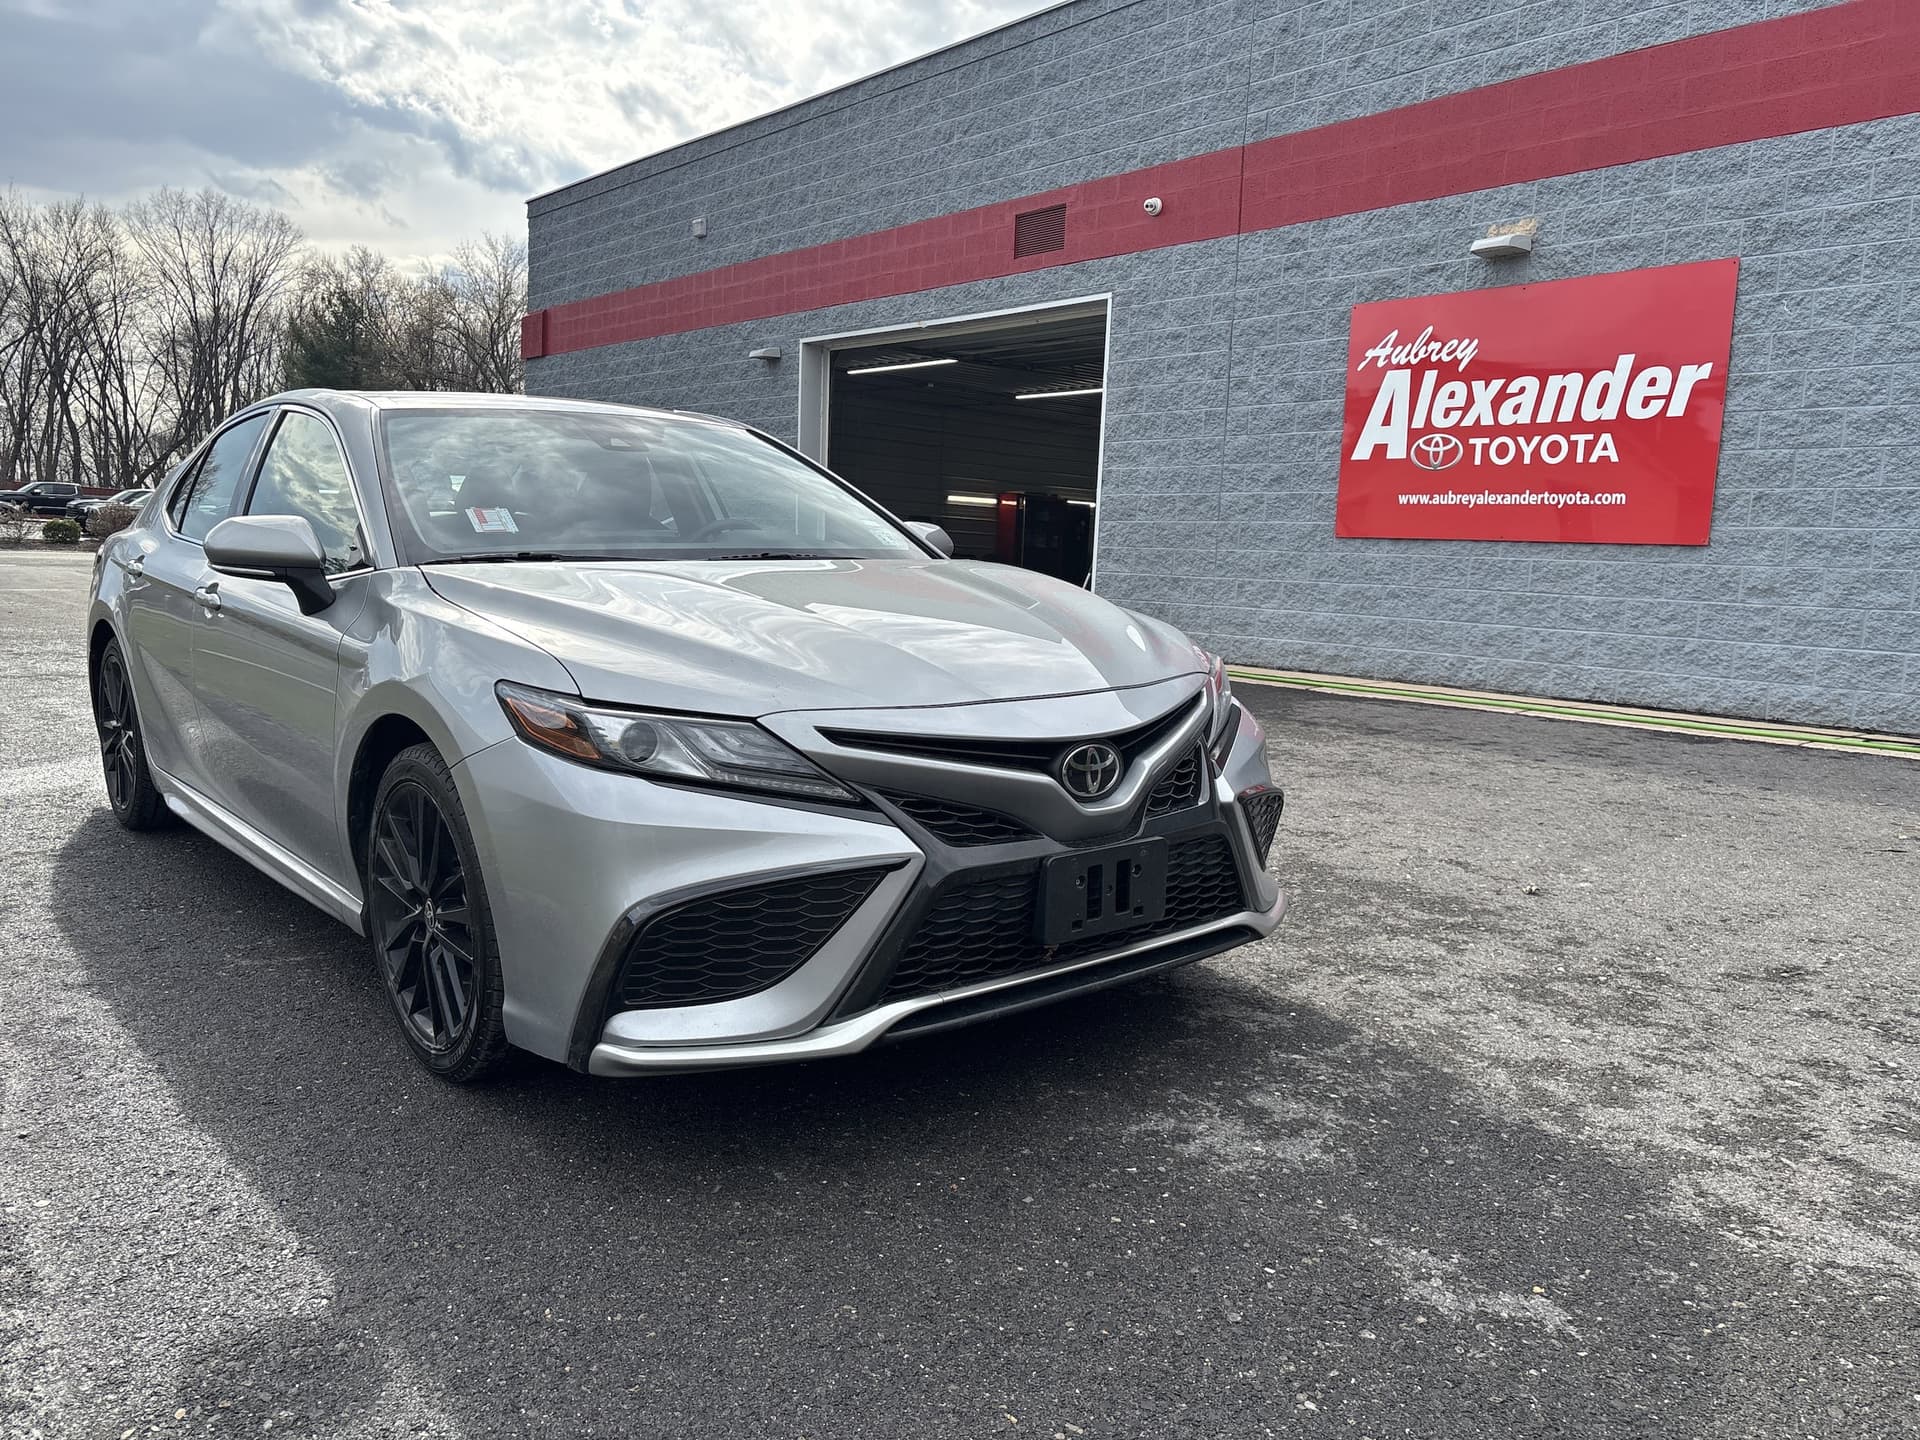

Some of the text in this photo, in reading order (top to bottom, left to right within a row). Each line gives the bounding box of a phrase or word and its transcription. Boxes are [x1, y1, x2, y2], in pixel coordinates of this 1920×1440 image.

[1357, 325, 1479, 373] Aubrey
[1350, 353, 1714, 461] Alexander
[1468, 432, 1620, 466] TOYOTA
[1398, 489, 1627, 509] www.aubreyalexandertoyota.com
